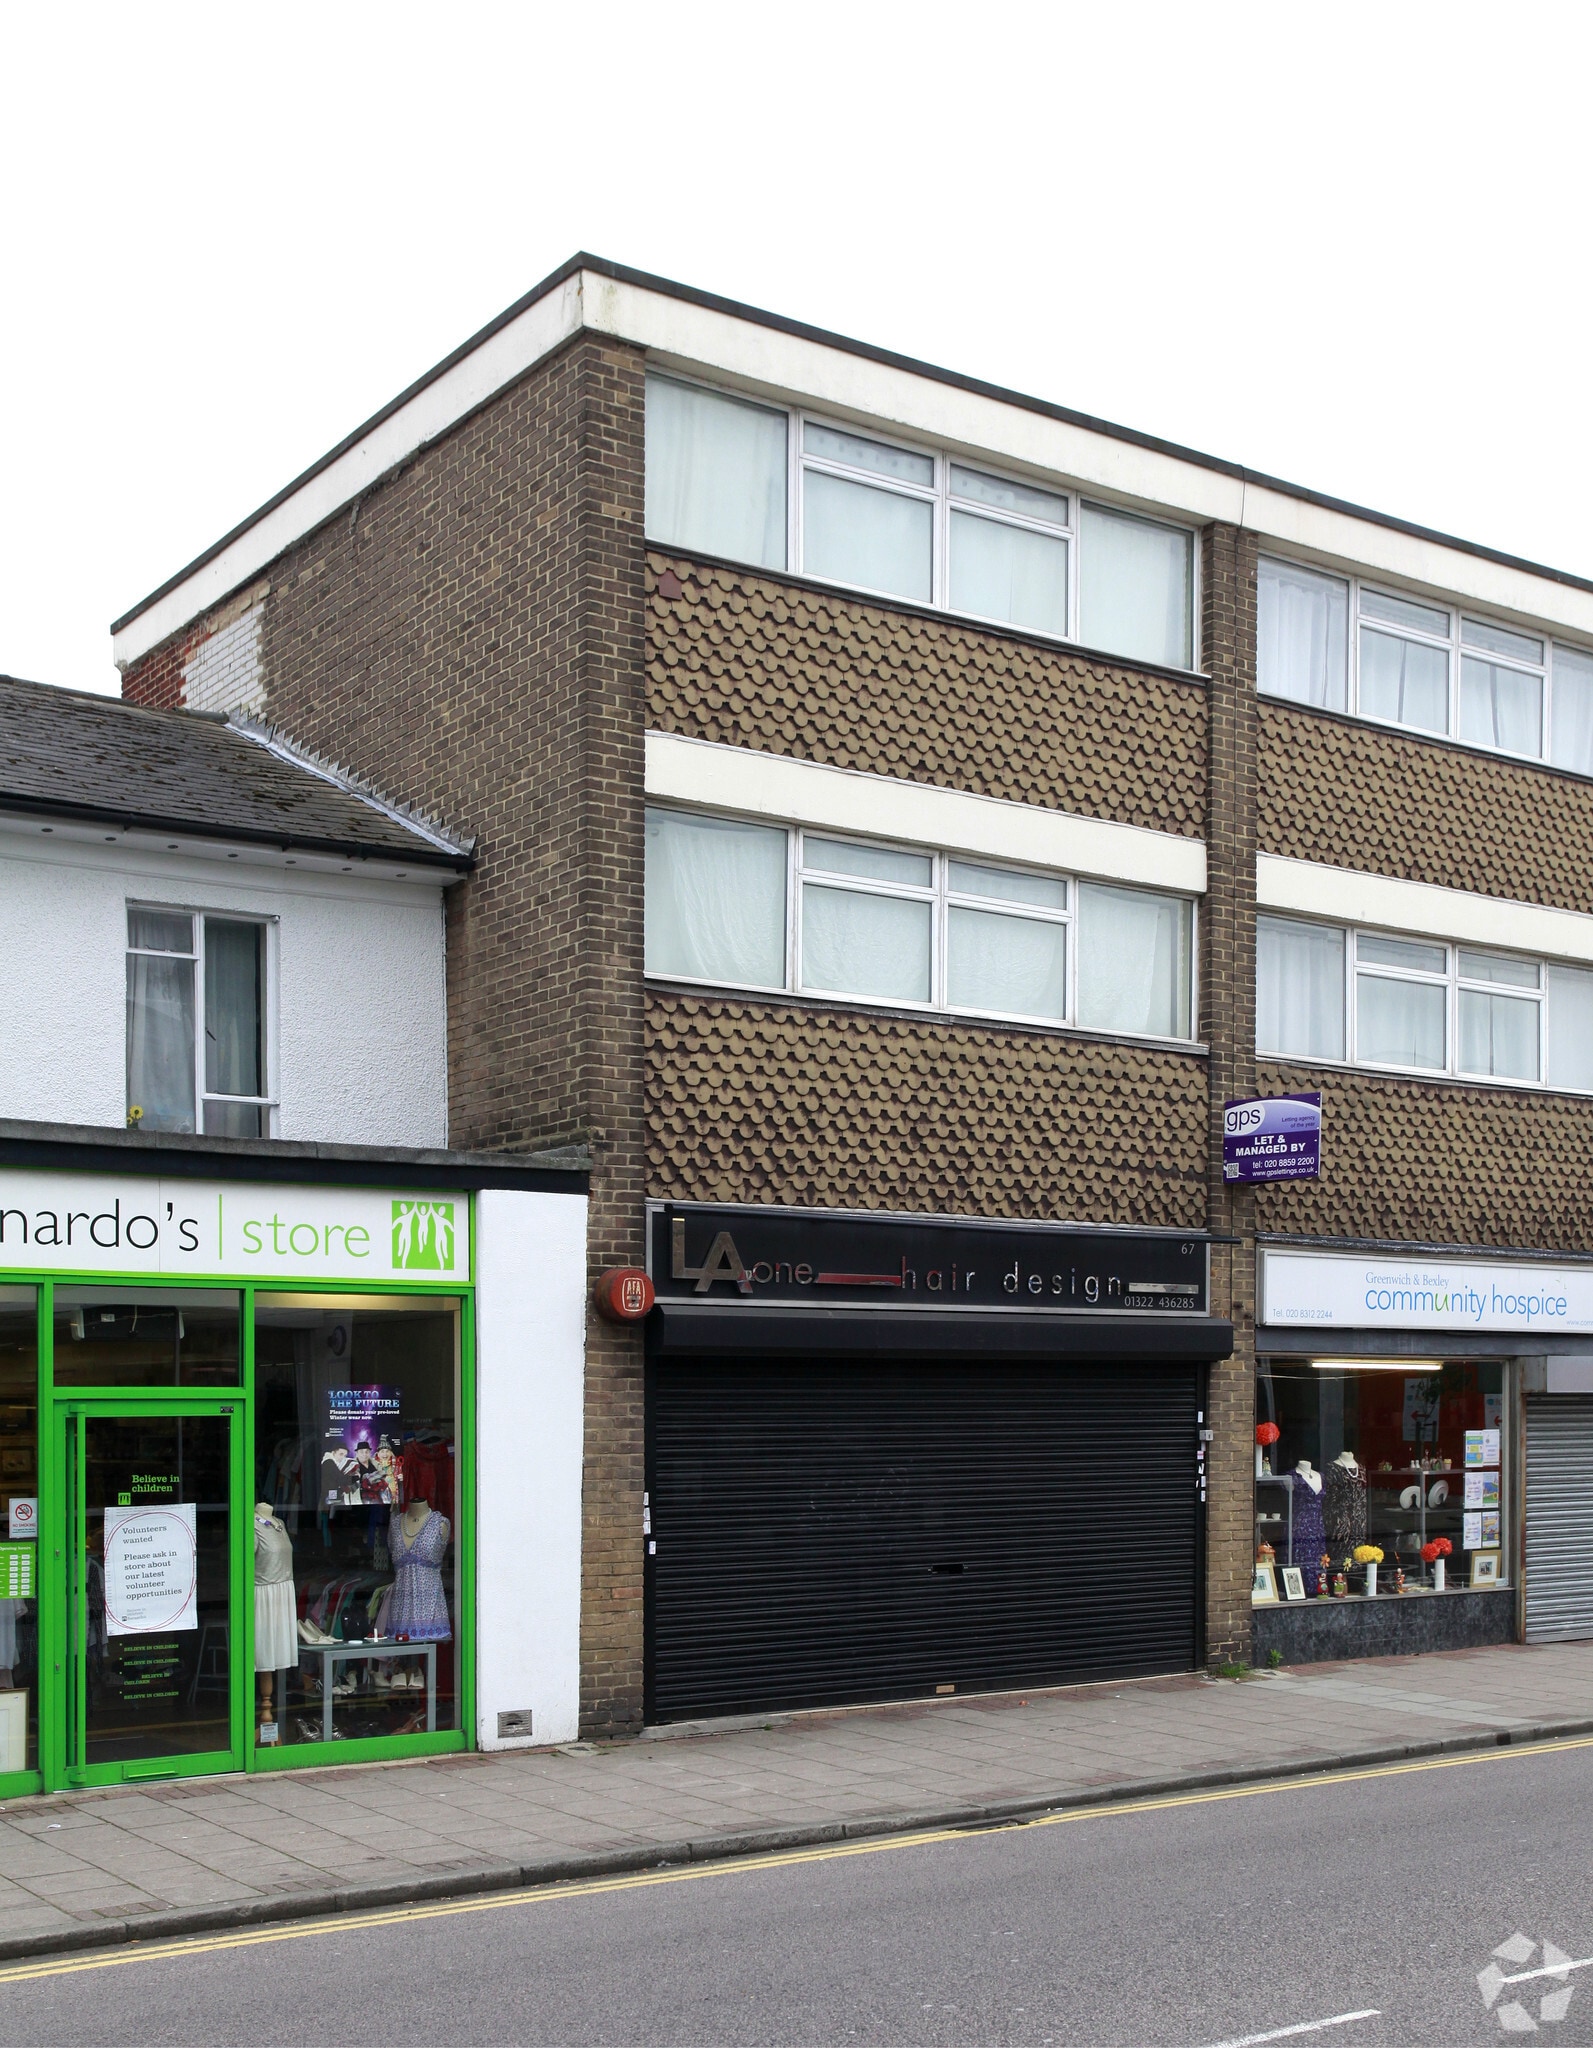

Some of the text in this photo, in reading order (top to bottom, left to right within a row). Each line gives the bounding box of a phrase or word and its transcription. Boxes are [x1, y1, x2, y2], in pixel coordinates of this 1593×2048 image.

[1227, 1109, 1260, 1132] gps
[1254, 1134, 1285, 1145] LET &
[1235, 1142, 1306, 1156] MANAGED BY
[1252, 1157, 1315, 1169] tel: 020 8859 2200
[1252, 1166, 1314, 1177] www.gpslettings.co.uk
[0, 1199, 370, 1257] nardo's store
[1181, 1243, 1195, 1254] 67
[672, 1217, 1121, 1303] LA one hair design
[1366, 1271, 1449, 1289] Greenwich & Bexley
[626, 1281, 641, 1295] AFA
[1124, 1296, 1195, 1308] 01322 436285
[1365, 1284, 1567, 1322] community hospice
[1286, 1309, 1298, 1318] 020
[1300, 1309, 1315, 1318] 8312
[1316, 1310, 1333, 1318] 2244
[329, 1390, 379, 1399] LOOK TO
[330, 1399, 400, 1408] THE FUTURE
[132, 1474, 180, 1483] Believe in
[132, 1484, 173, 1492] children
[122, 1525, 167, 1534] Volunteers
[123, 1536, 153, 1544] wanted
[124, 1553, 151, 1561] Please
[148, 1560, 171, 1568] about
[142, 1571, 165, 1579] latest
[126, 1580, 165, 1590] volunteer
[126, 1588, 183, 1600] opportunities
